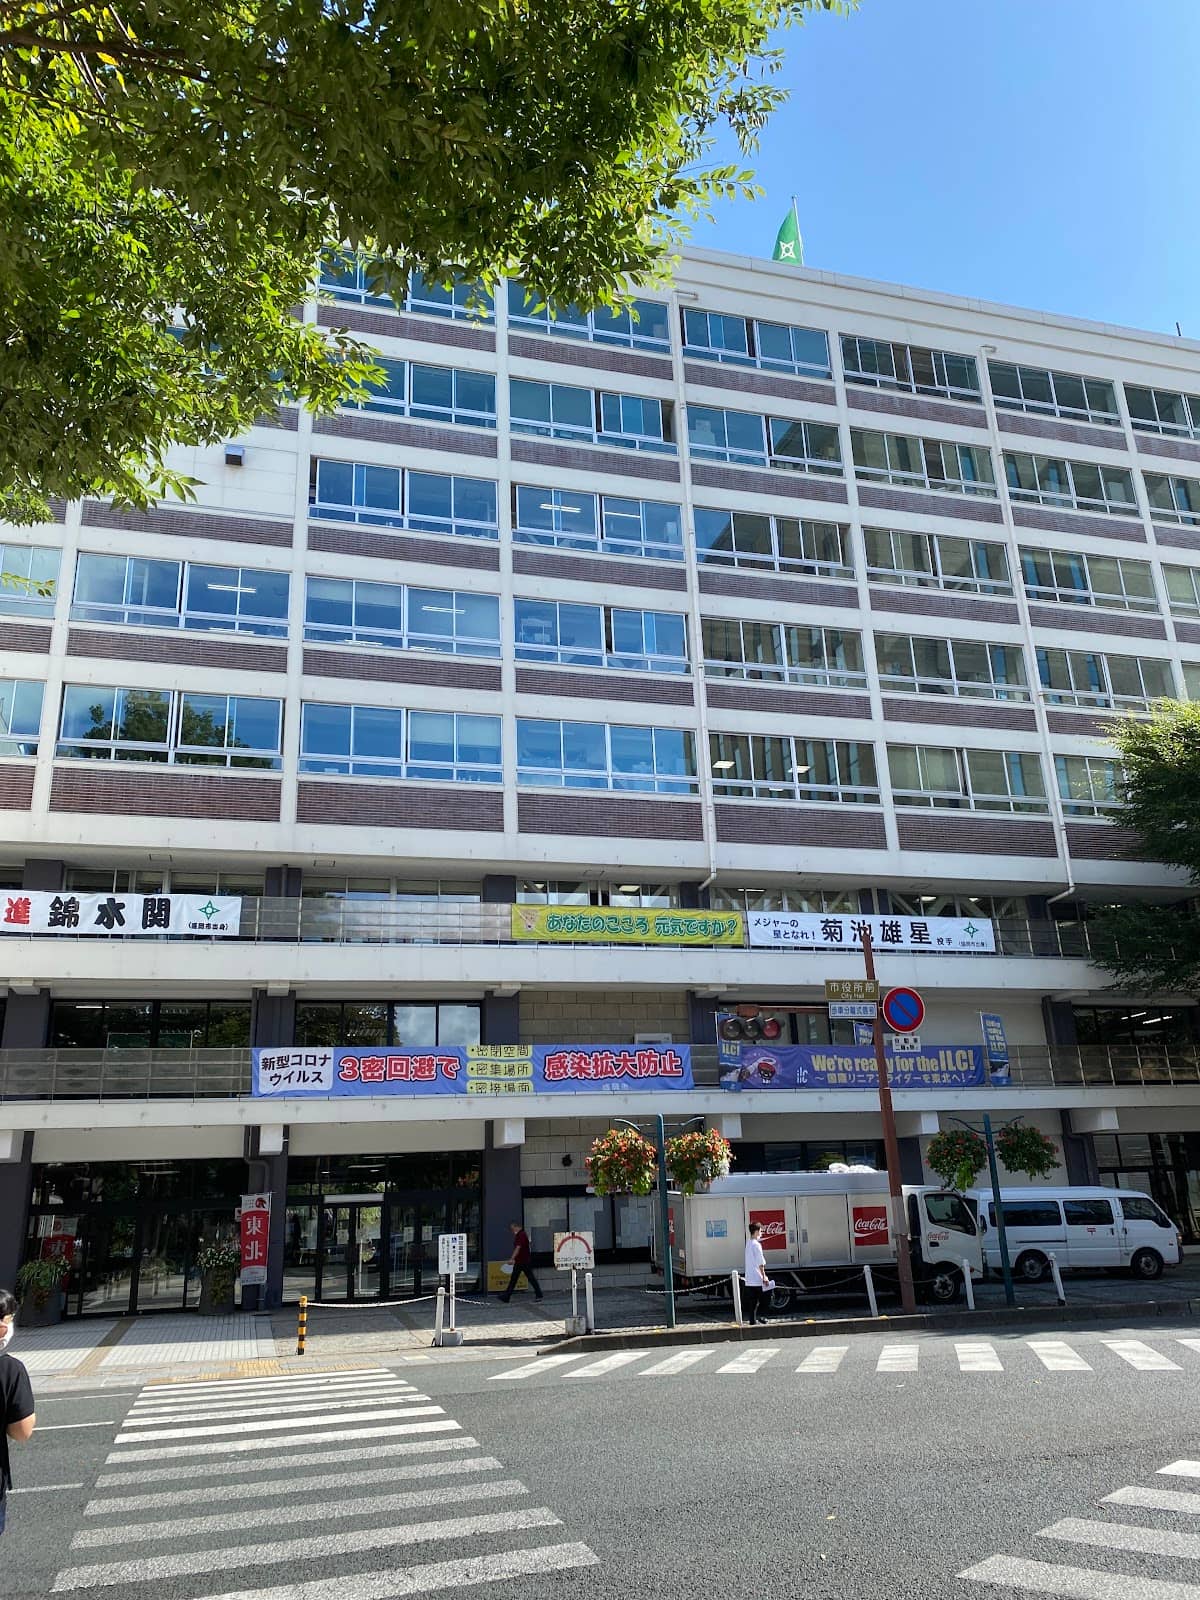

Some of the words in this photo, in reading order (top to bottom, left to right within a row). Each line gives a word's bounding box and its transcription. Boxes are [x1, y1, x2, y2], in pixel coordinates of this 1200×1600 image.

[4, 897, 32, 925] 進
[547, 913, 649, 934] あなたのこころ
[753, 917, 799, 928] メジャーの
[820, 918, 932, 945] 菊池雄星
[936, 936, 953, 946] 投手
[828, 982, 875, 993] 市役所前
[841, 992, 853, 1000] City
[261, 1054, 331, 1071] 新型コロナ
[543, 1050, 684, 1081] 感染拡大防止
[811, 1055, 853, 1072] We're
[855, 1057, 894, 1074] reay
[895, 1056, 914, 1072] for
[916, 1056, 939, 1072] the
[939, 1050, 976, 1072] ILC!
[269, 1070, 323, 1086] ウイルス
[854, 1218, 887, 1231] Coca-Cola
[244, 1215, 264, 1261] 東北
